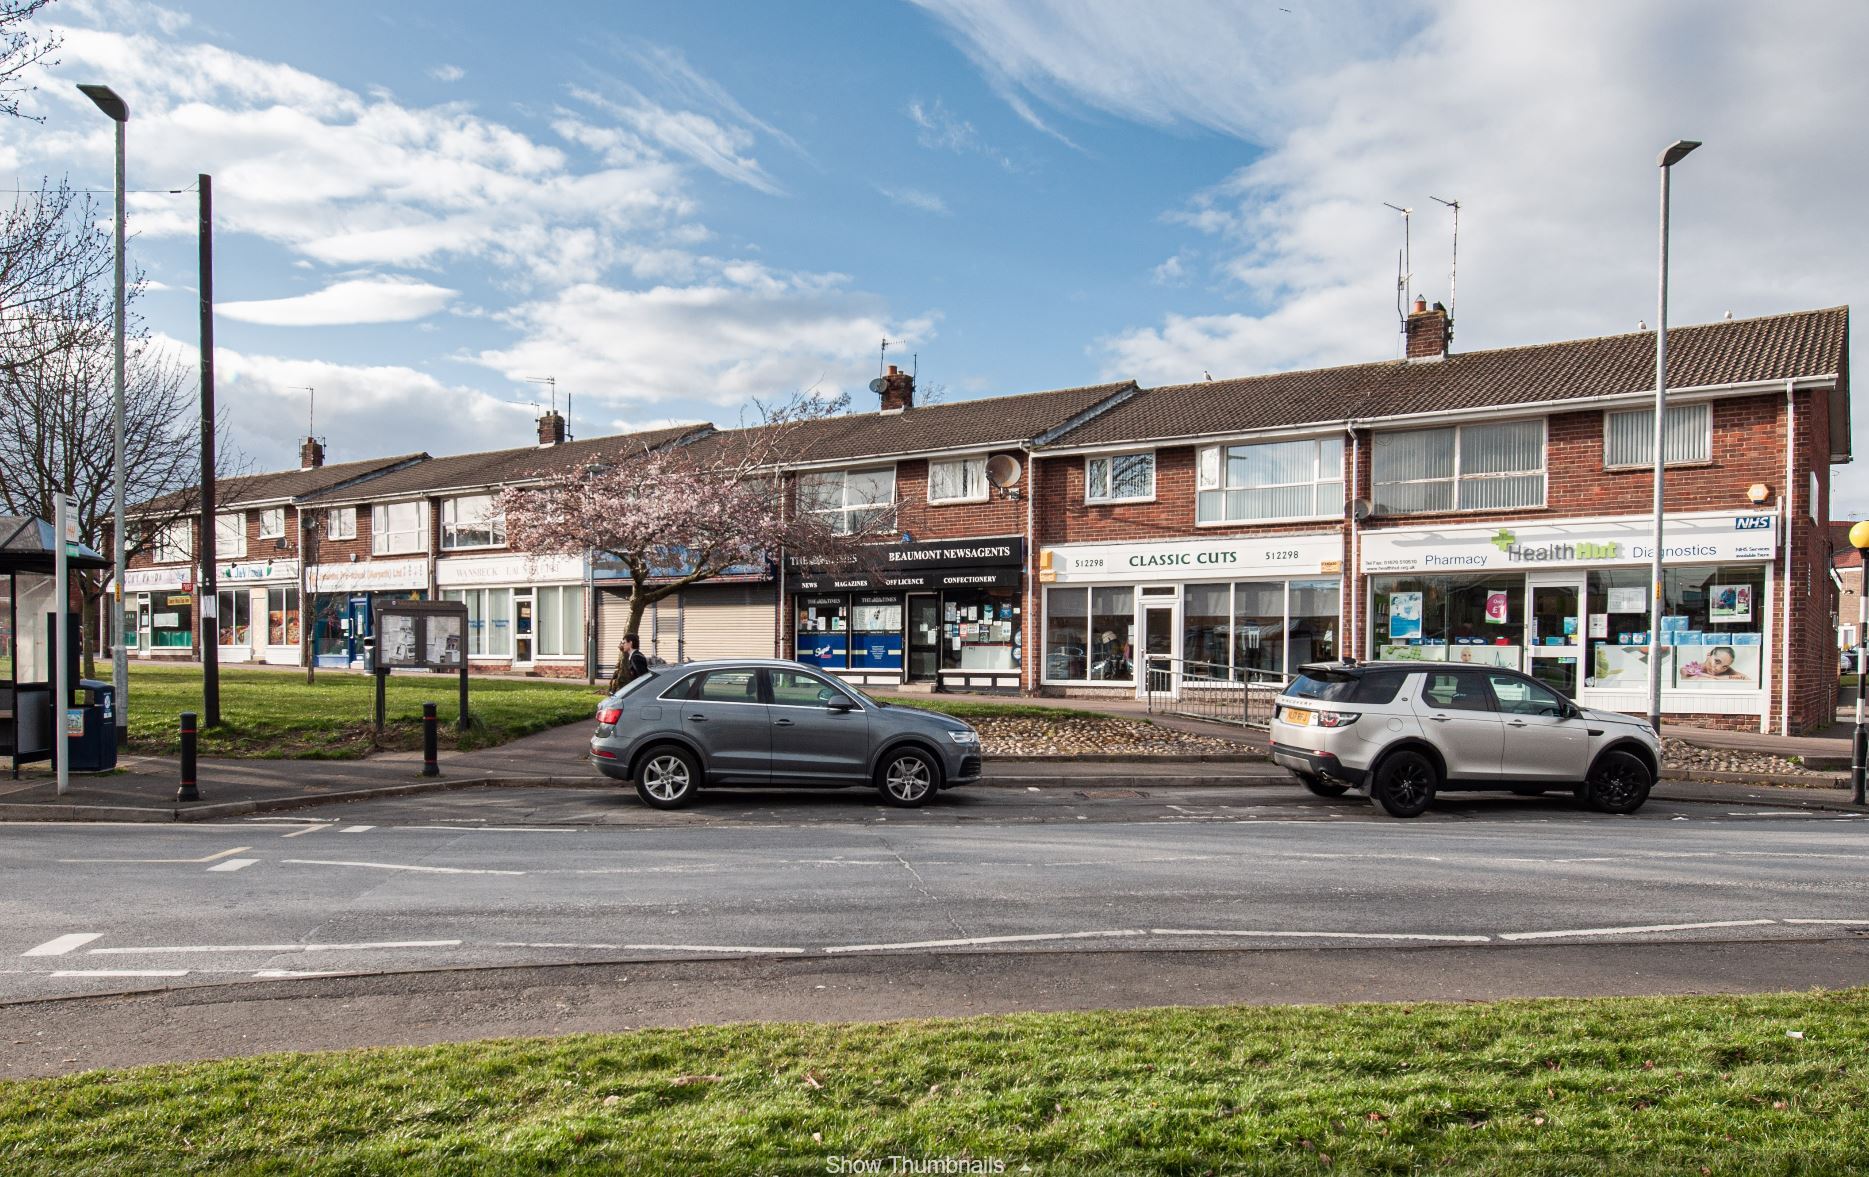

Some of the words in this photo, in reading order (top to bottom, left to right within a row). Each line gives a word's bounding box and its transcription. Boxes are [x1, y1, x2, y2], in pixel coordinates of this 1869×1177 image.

[1736, 517, 1768, 529] NHS
[888, 550, 942, 562] BEAUMONT
[943, 546, 1010, 560] NEWSAGENTS
[1265, 550, 1299, 560] 512298
[1633, 544, 1717, 559] Dianostics
[1075, 559, 1104, 568] 512298
[1129, 553, 1191, 567] CLASSIC
[1196, 551, 1238, 564] CUTS
[1425, 554, 1488, 567] Pharmacy
[456, 567, 498, 577] WANSBECK
[834, 580, 868, 588] MAGAZINES
[898, 578, 924, 586] LICENCE
[943, 575, 997, 584] CONFECTIONERY
